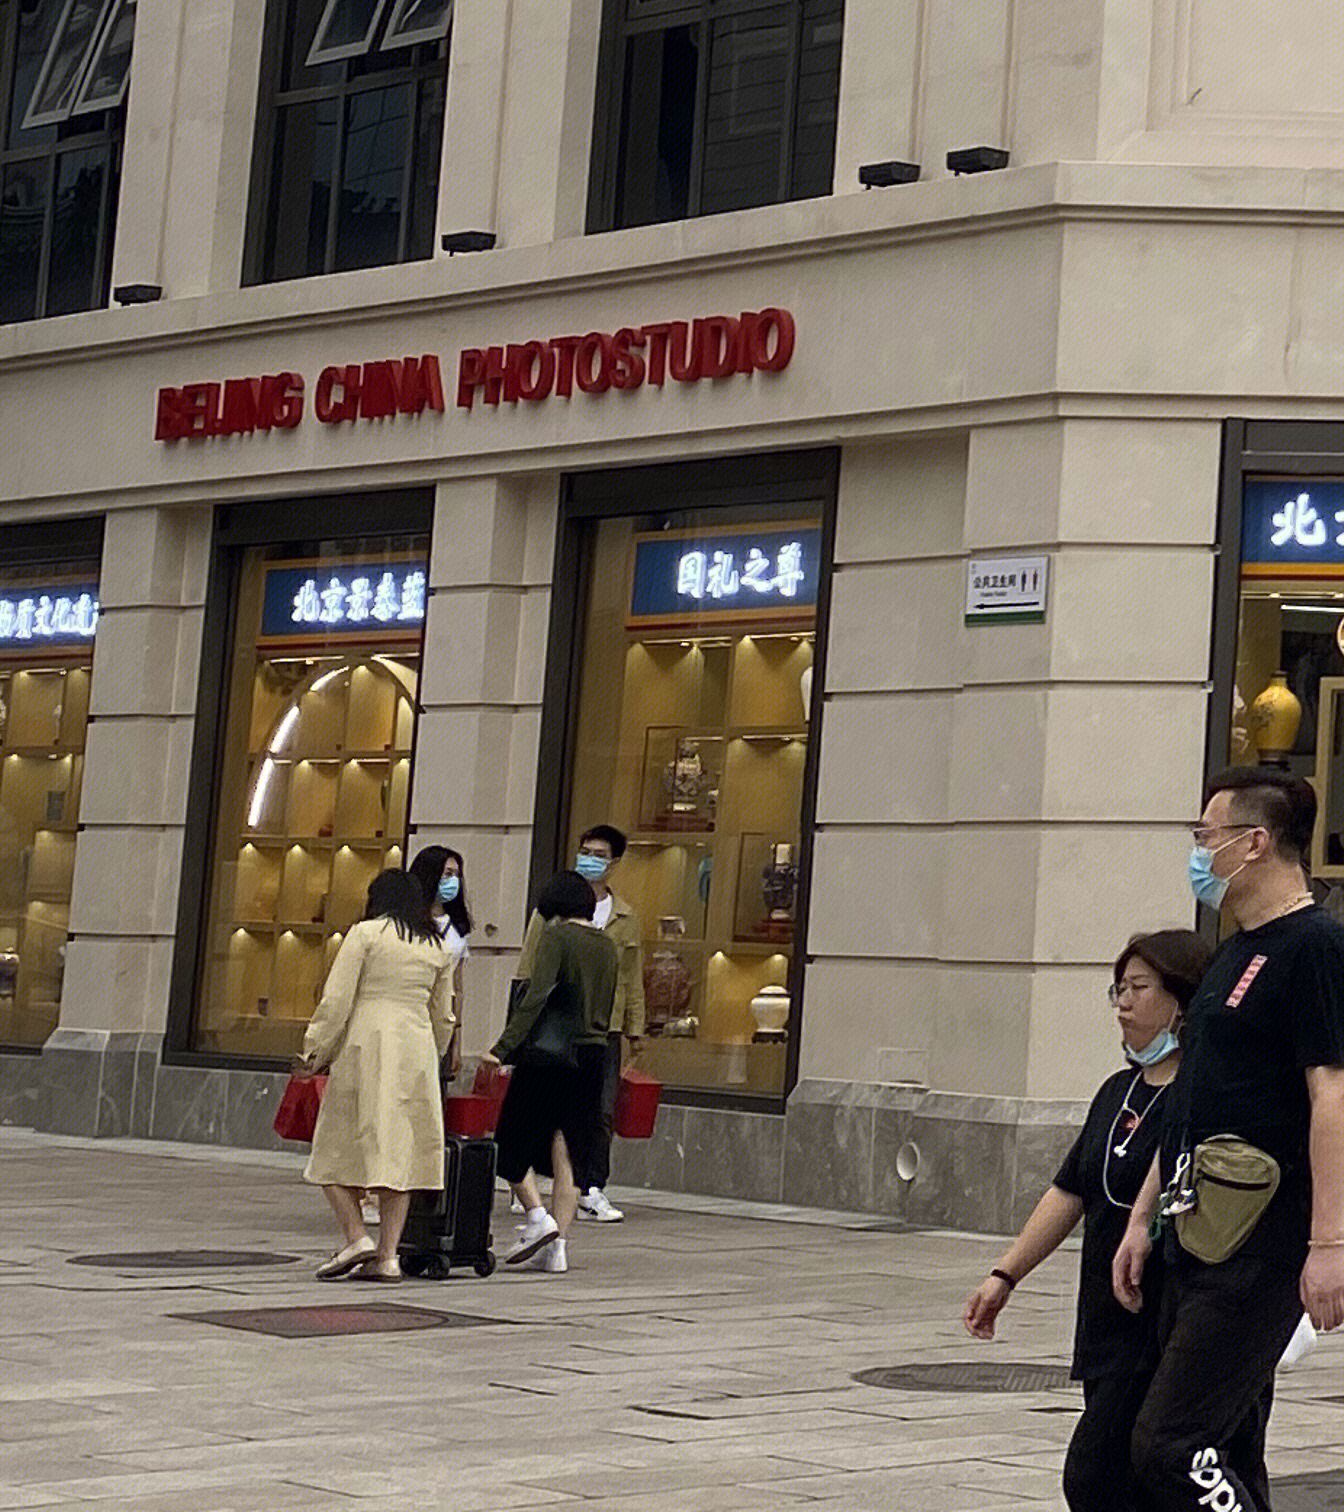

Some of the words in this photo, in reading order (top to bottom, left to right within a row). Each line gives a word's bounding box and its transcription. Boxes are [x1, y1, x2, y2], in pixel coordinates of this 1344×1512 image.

[155, 372, 305, 441] BEIJING
[315, 355, 445, 424] CHINA
[457, 308, 795, 409] PHOTOSTUDIO
[292, 572, 425, 623] 北京景泰蓝
[677, 542, 804, 598] 国礼之尊
